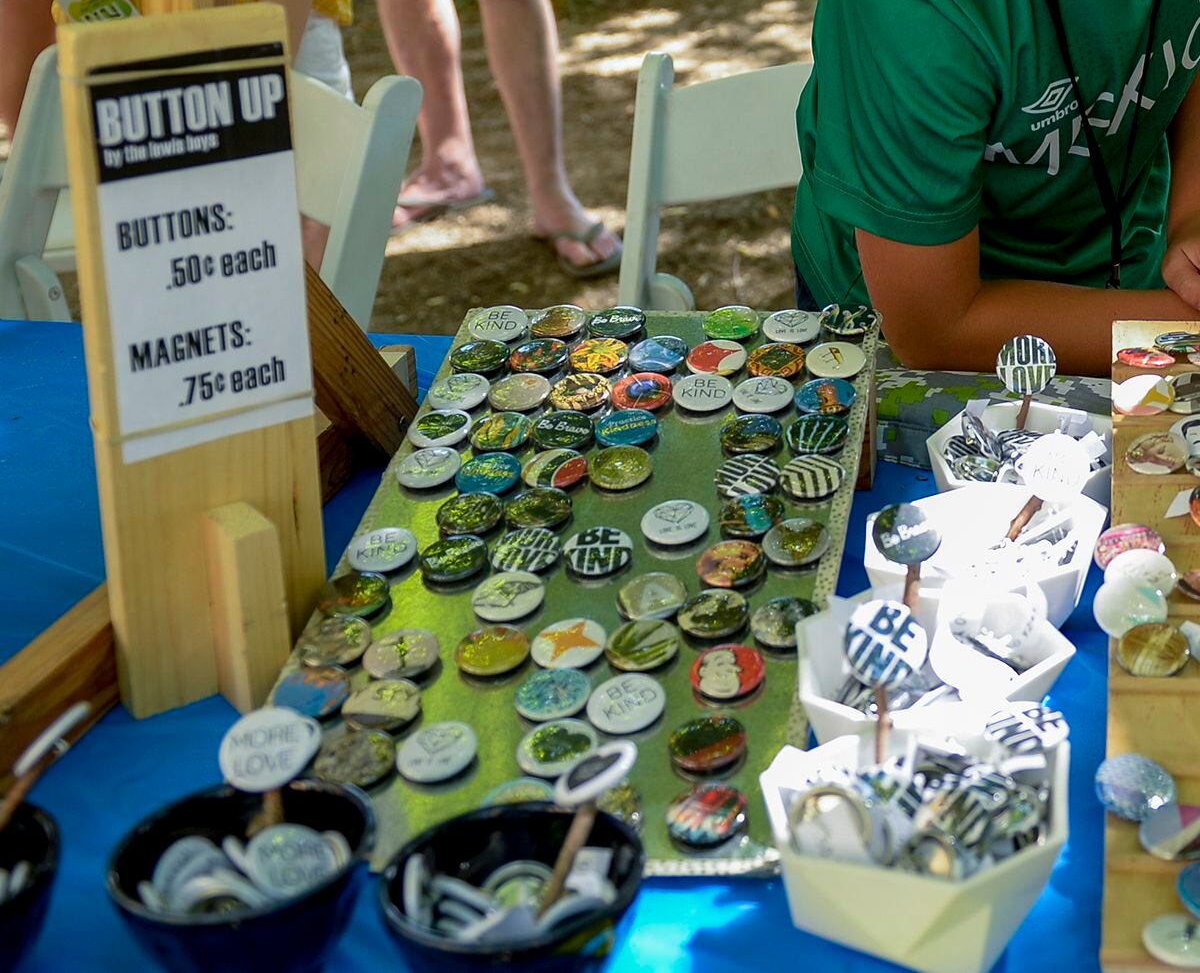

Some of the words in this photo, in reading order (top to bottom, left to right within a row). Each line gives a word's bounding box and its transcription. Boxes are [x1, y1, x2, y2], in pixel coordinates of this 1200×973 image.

[96, 81, 234, 147] BUTTON
[238, 73, 285, 122] UP
[1031, 99, 1079, 132] umbro
[103, 148, 123, 168] by
[124, 142, 148, 164] the
[186, 133, 219, 154] boys
[115, 203, 234, 252] BUTTONS:
[220, 240, 277, 277] each
[474, 320, 518, 331] KIND
[487, 310, 512, 320] BE
[128, 320, 252, 373] MAGNETS:
[230, 355, 285, 393] each
[694, 378, 718, 389] BE
[681, 388, 727, 399] KIND
[369, 531, 397, 545] BE
[577, 527, 621, 545] BE
[356, 542, 408, 560] KIND
[869, 605, 916, 653] BE
[607, 679, 639, 700] BE
[603, 688, 657, 720] KIND
[230, 725, 301, 750] MORE
[232, 749, 293, 777] LOVE
